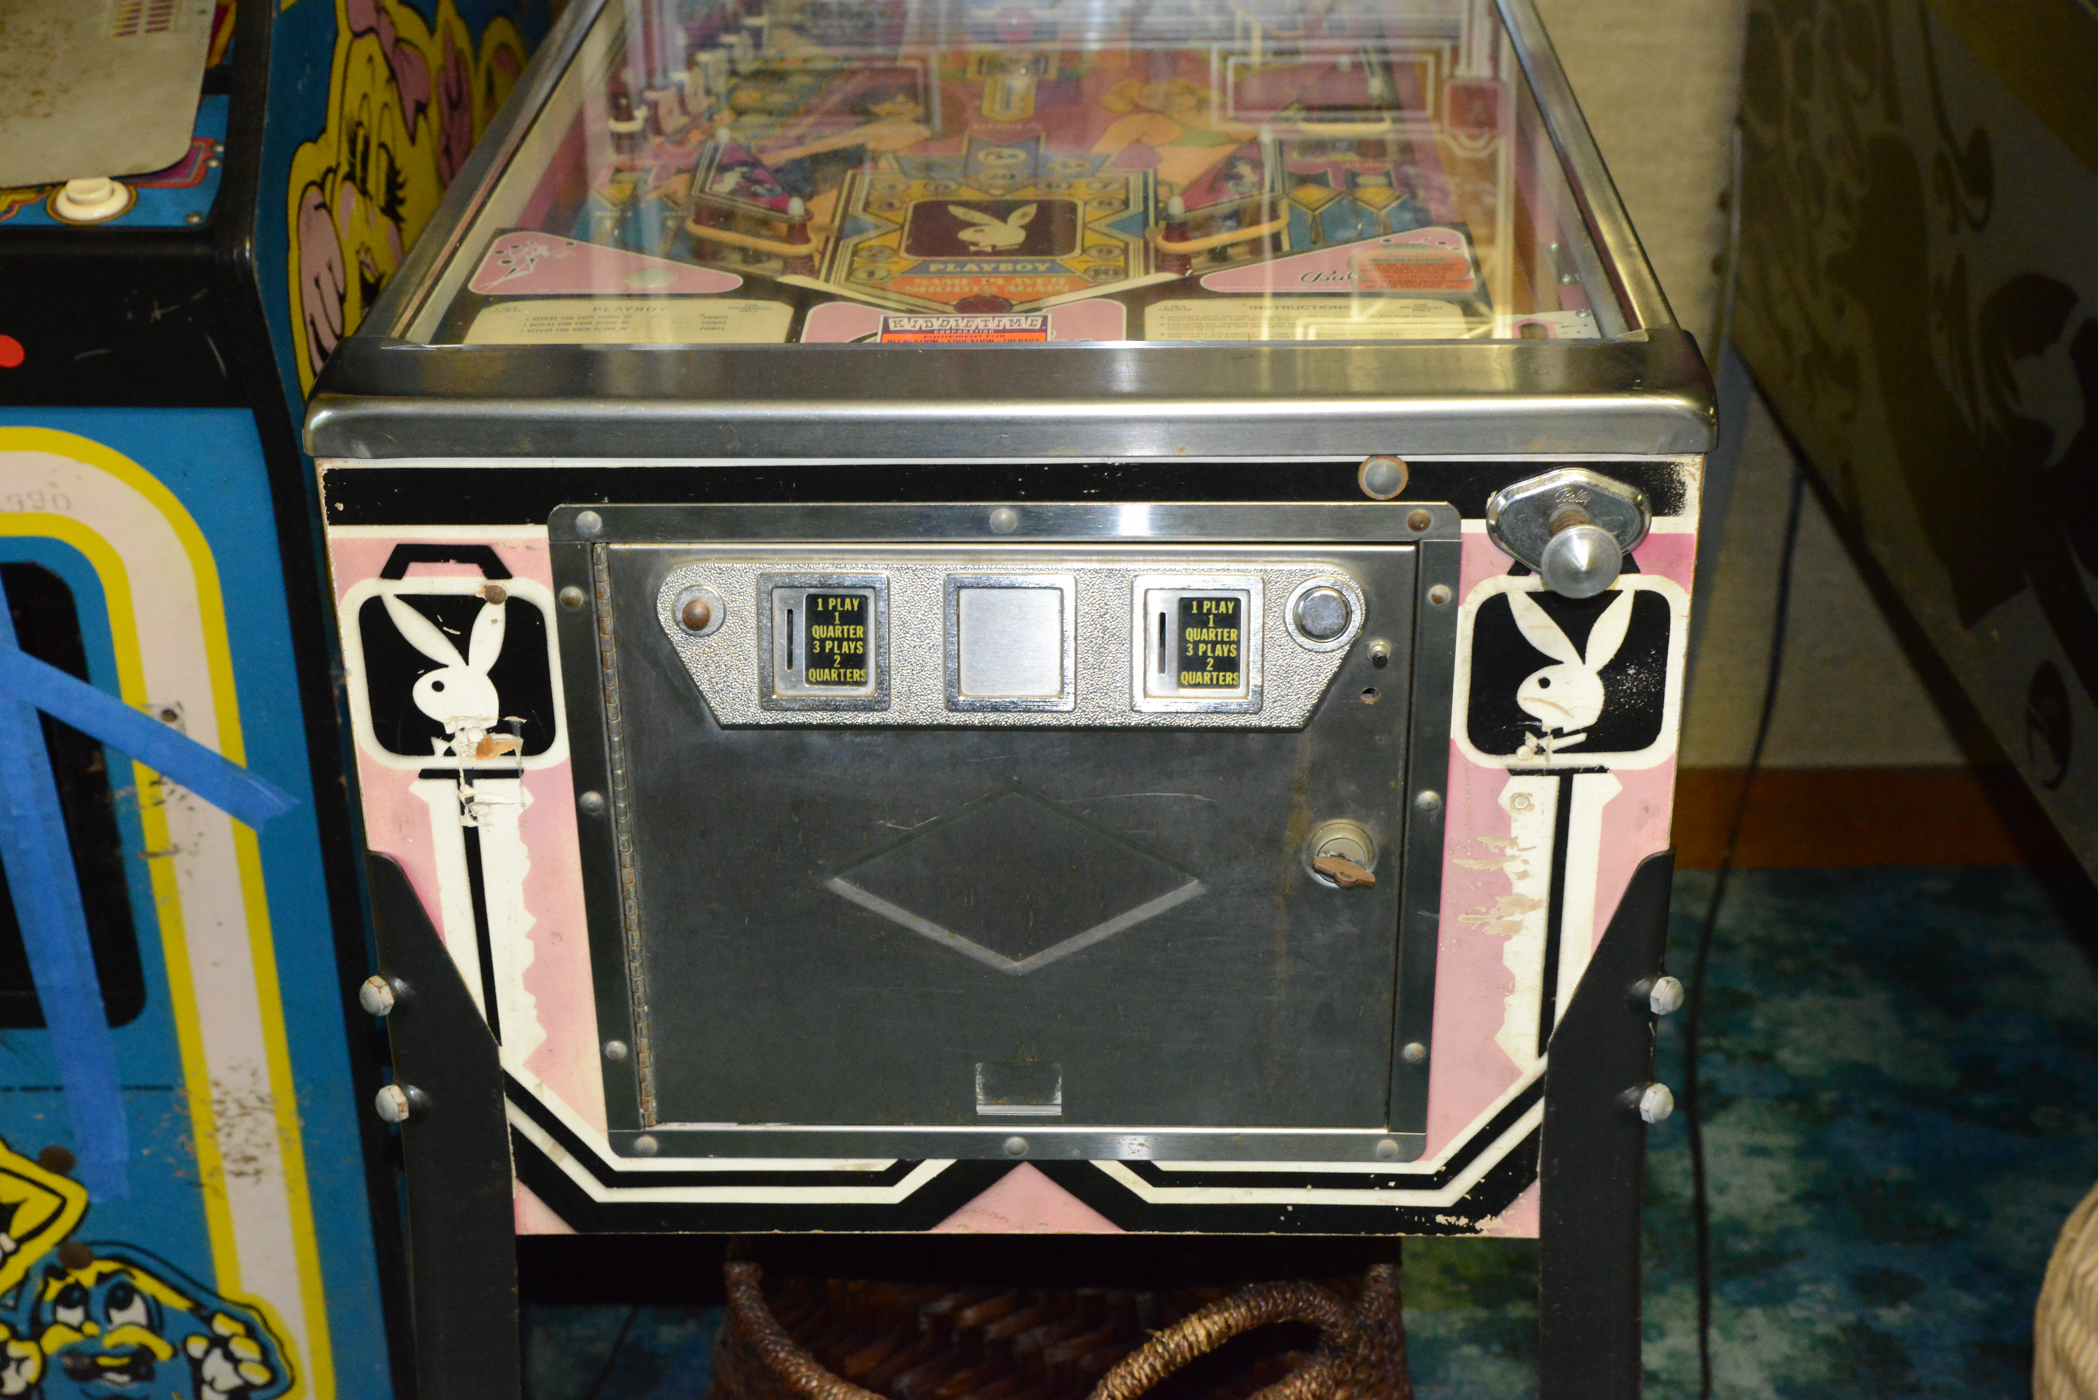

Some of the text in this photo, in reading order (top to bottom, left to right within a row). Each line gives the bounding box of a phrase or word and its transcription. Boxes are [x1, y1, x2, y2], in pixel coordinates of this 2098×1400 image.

[928, 263, 1051, 272] PLAYBOY
[981, 277, 1066, 285] PLAYER
[1004, 284, 1069, 293] AGAIN
[889, 318, 1042, 330] KIDDIETIME
[817, 598, 860, 611] 1 PLAY
[1191, 601, 1235, 614] 1 PLAY
[834, 611, 840, 624] 1
[1208, 614, 1214, 627] 1
[812, 625, 864, 639] QUARTER
[1185, 628, 1238, 642] QUARTER
[813, 640, 864, 654] 3 PLAYS
[1186, 643, 1238, 657] 3 PLAYS
[833, 655, 841, 668] 2
[1206, 658, 1214, 670] 2
[808, 668, 868, 683] QUARTERS
[1180, 671, 1240, 685] QUARTERS
